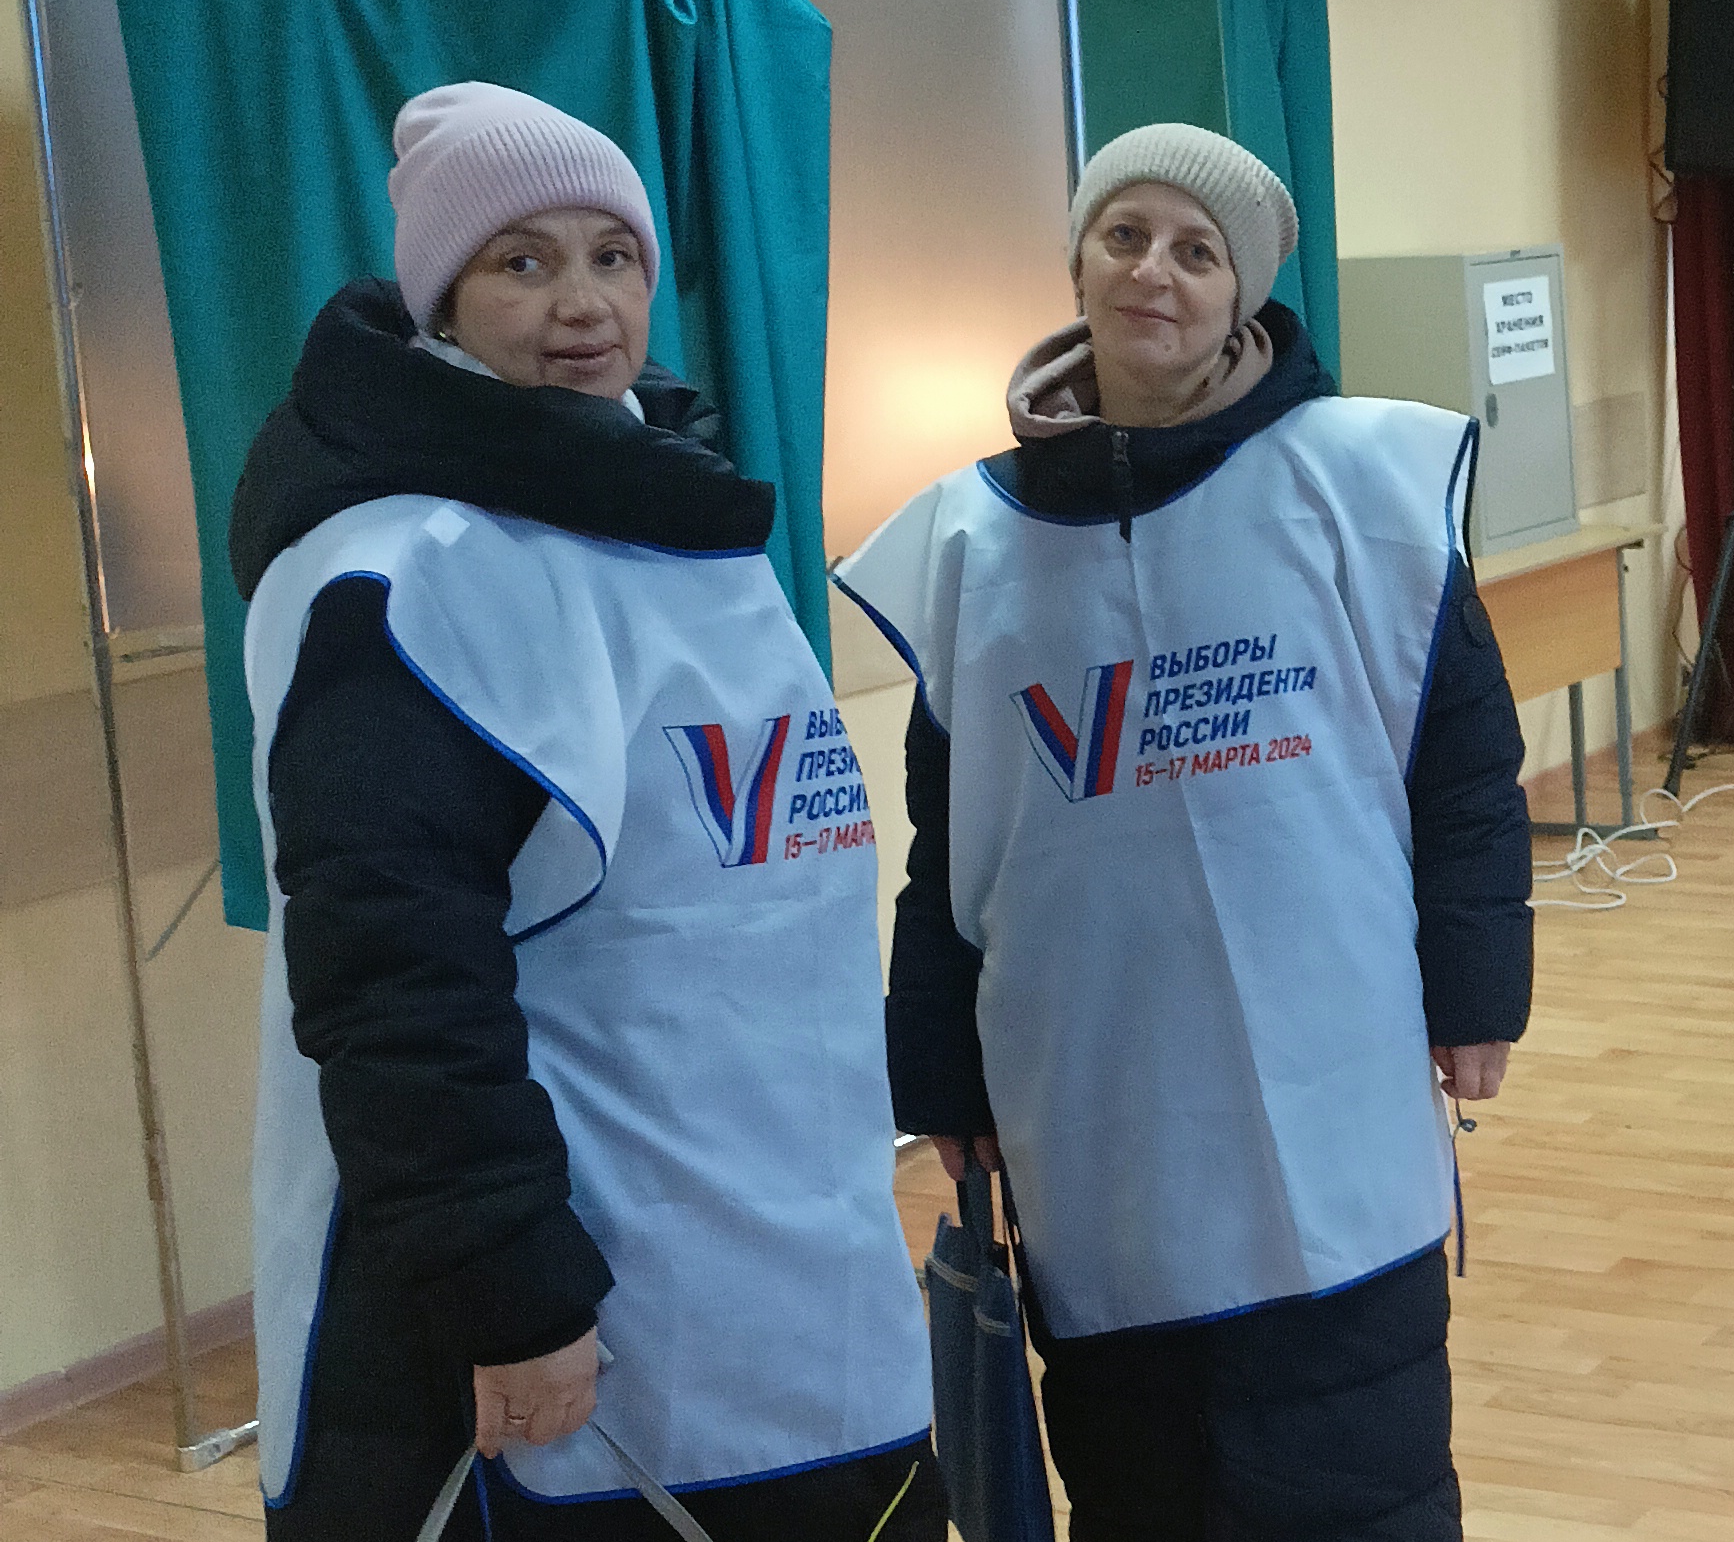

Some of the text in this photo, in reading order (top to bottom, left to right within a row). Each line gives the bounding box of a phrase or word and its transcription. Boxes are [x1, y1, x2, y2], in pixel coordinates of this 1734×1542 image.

[1150, 633, 1277, 681] ВЫБОРЫ
[1143, 666, 1317, 718] ПРЕЗИДЕНТА
[1138, 709, 1251, 756] РОССИИ
[1190, 743, 1260, 778] МАРТА
[1265, 734, 1312, 763] 2024
